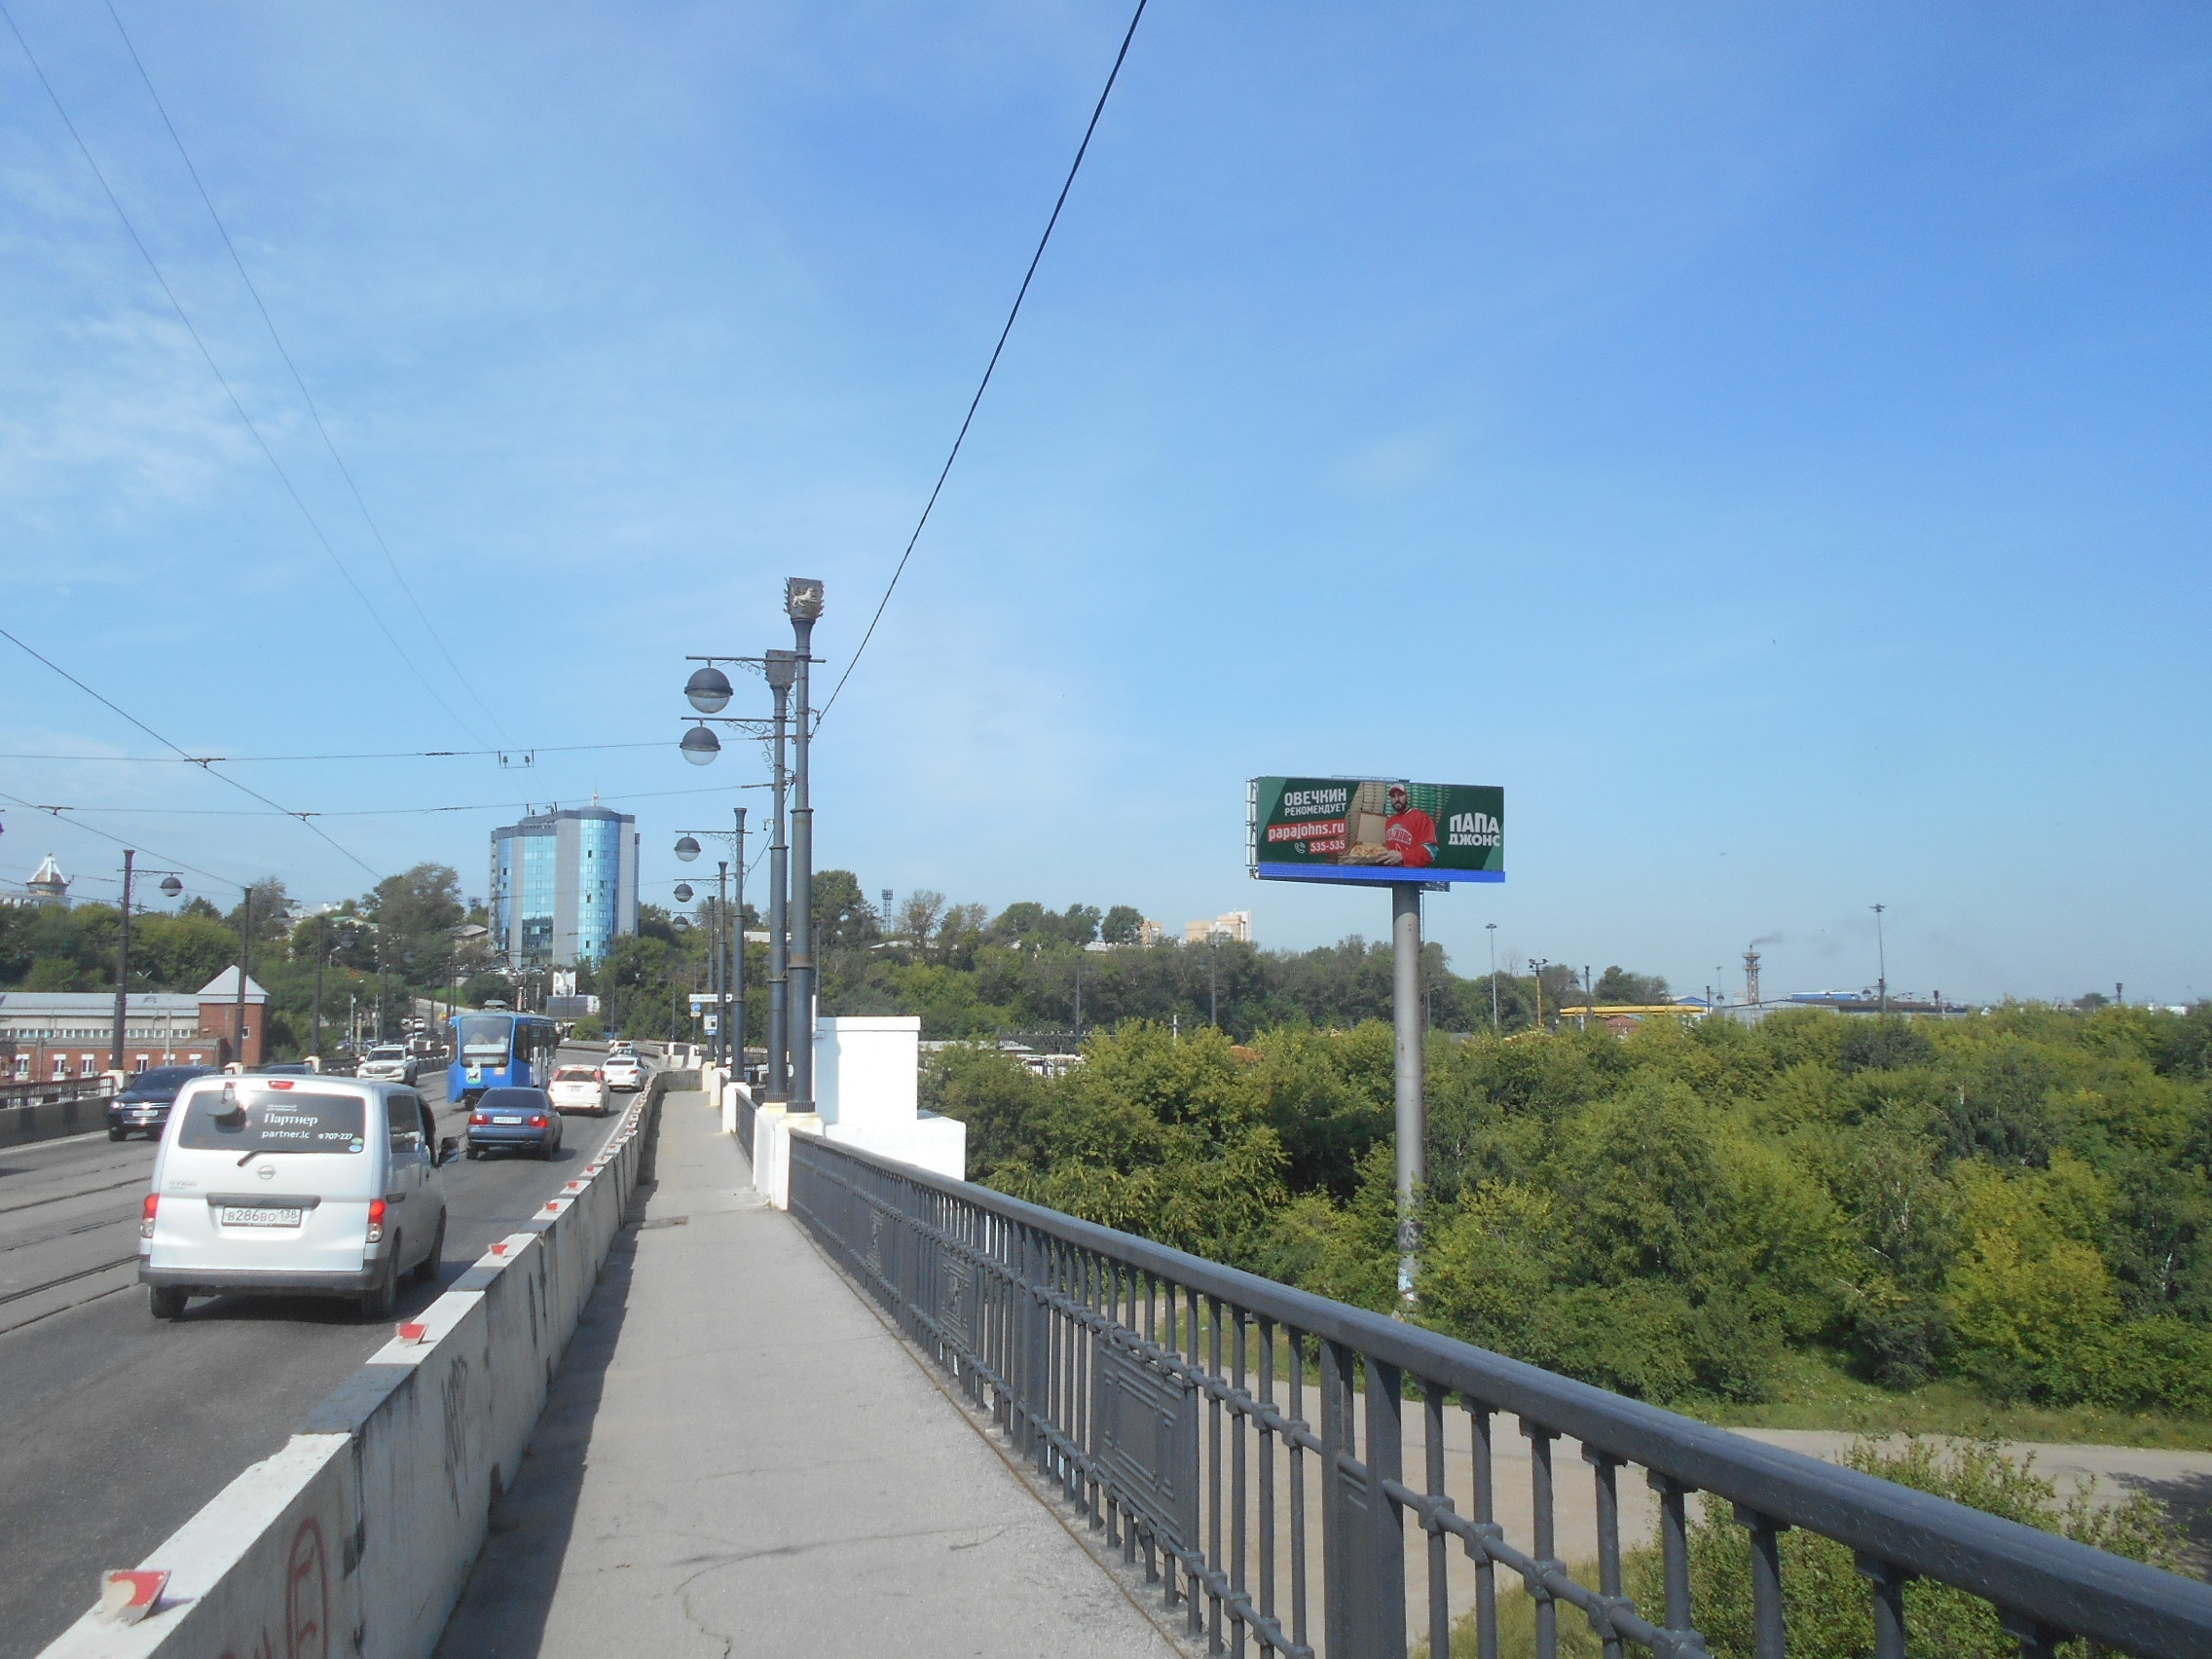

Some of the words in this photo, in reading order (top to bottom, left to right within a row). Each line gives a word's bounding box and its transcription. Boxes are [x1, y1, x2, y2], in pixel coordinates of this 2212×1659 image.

[1284, 788, 1346, 806] ОВЕЧКИН
[1284, 802, 1346, 817] РЕКОМЕНДУЕТ
[1450, 812, 1500, 833] ПАПА
[1269, 823, 1345, 841] papajohns.ru
[1448, 832, 1500, 847] ДЖОНС
[1309, 839, 1346, 852] 535-535
[264, 1113, 318, 1126] Партнер
